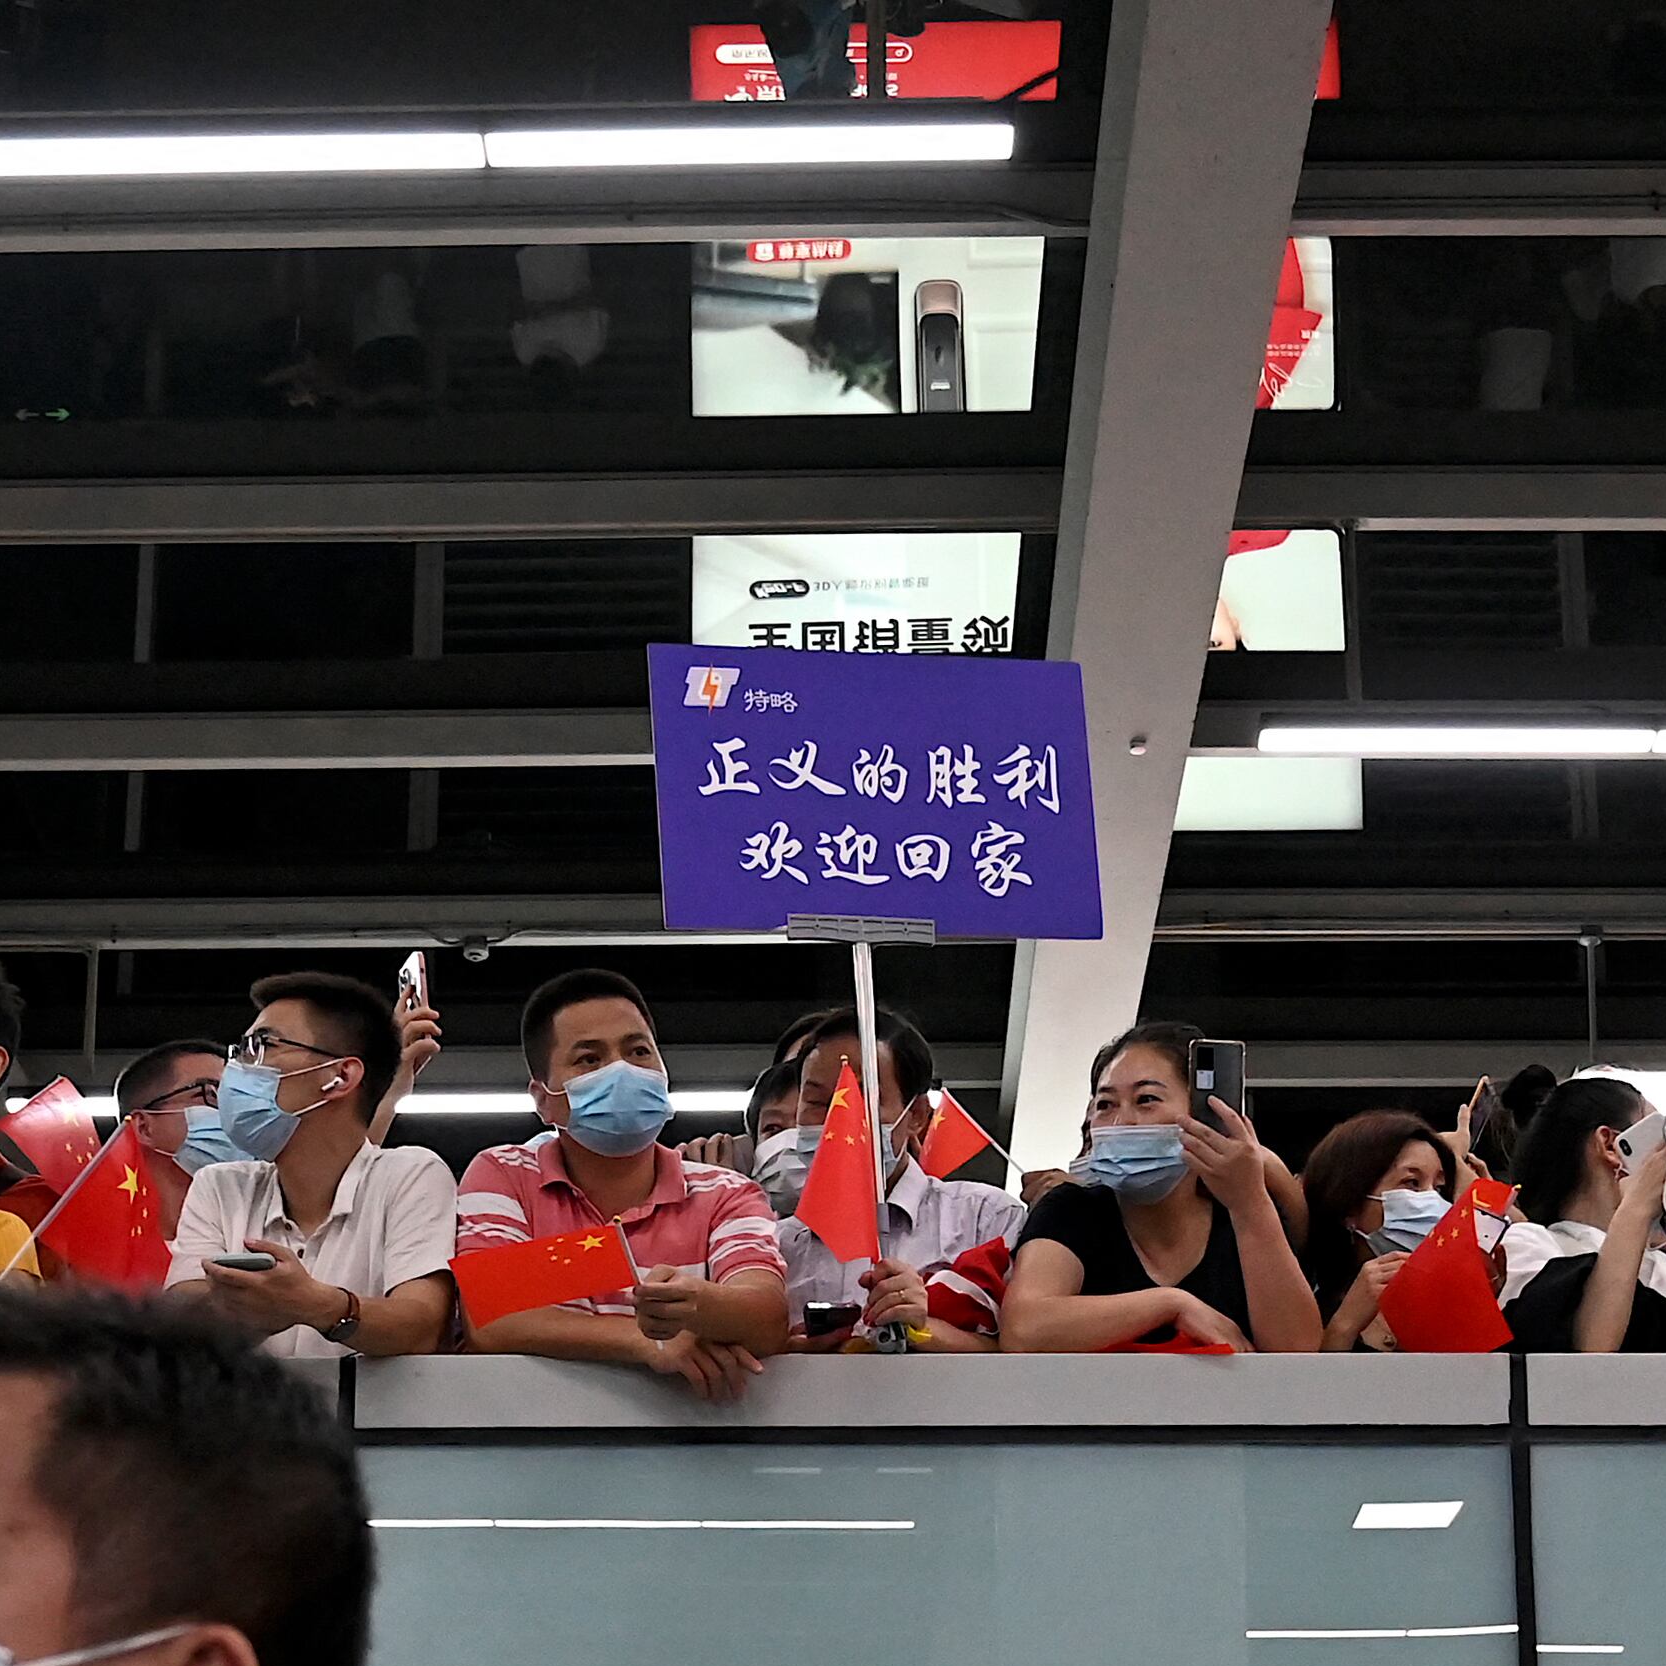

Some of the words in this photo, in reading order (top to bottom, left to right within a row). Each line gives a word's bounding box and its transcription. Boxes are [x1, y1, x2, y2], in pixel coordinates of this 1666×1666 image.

[743, 688, 799, 714] 特略
[697, 736, 1061, 815] 正义的胜利
[739, 820, 1034, 898] 欢迎回家
